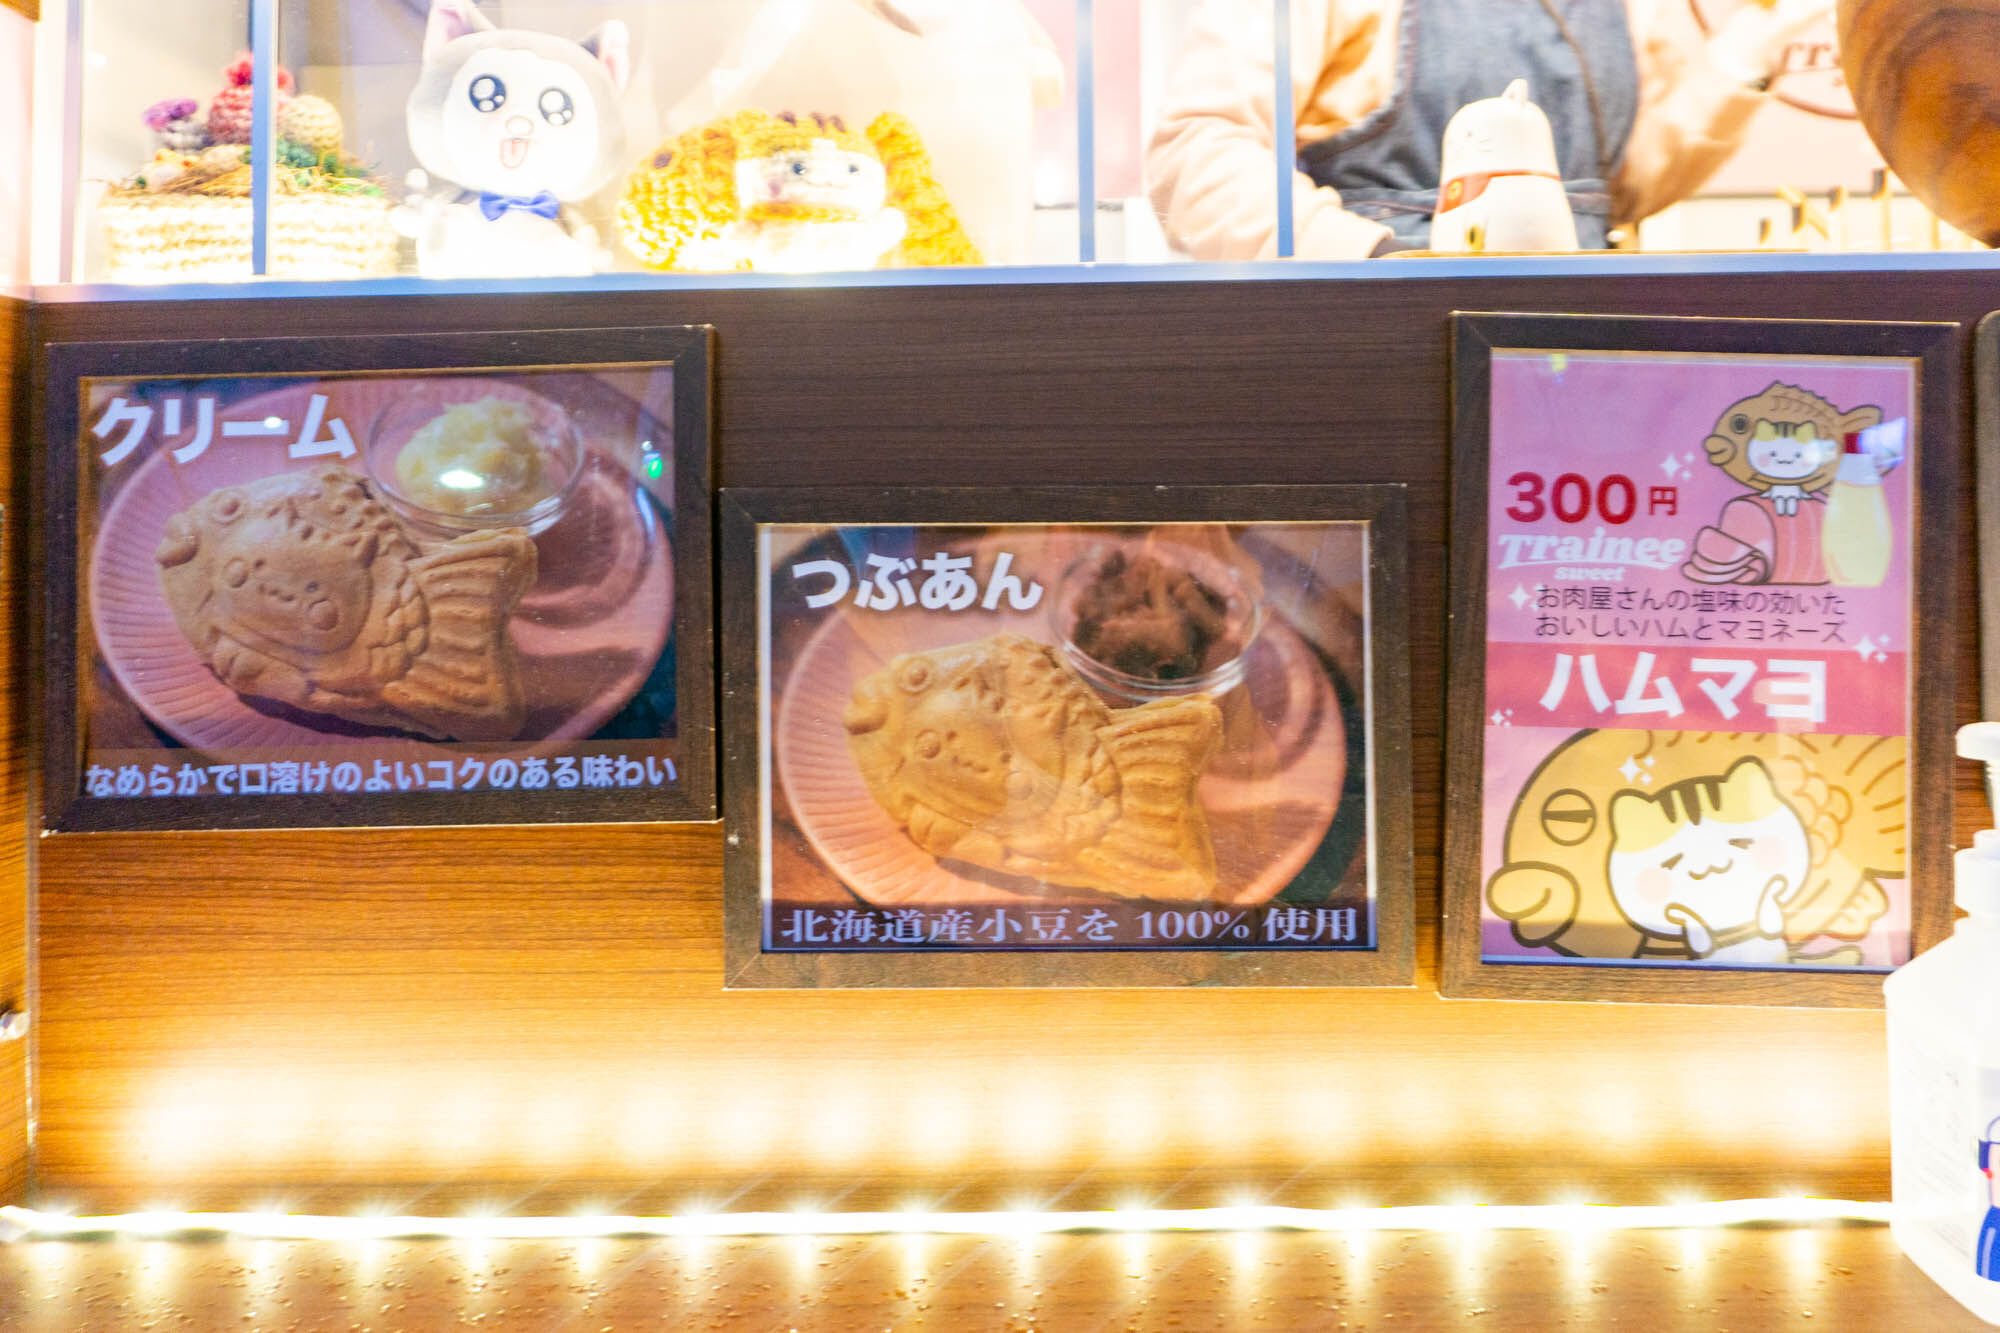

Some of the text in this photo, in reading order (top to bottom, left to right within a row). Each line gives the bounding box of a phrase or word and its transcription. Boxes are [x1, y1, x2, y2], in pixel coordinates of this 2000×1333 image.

[92, 394, 357, 467] クリーム
[1498, 525, 1687, 569] Trainee
[791, 551, 1044, 612] つぶあん
[1553, 566, 1626, 582] sweet
[1536, 585, 1846, 616] お肉屋さんの塩味の効いた
[1536, 614, 1847, 643] おいしいハムとマヨネーズ
[1539, 650, 1827, 724] ハムマヨ
[85, 754, 679, 799] なめらかで口溶けのよいコクのある味わい
